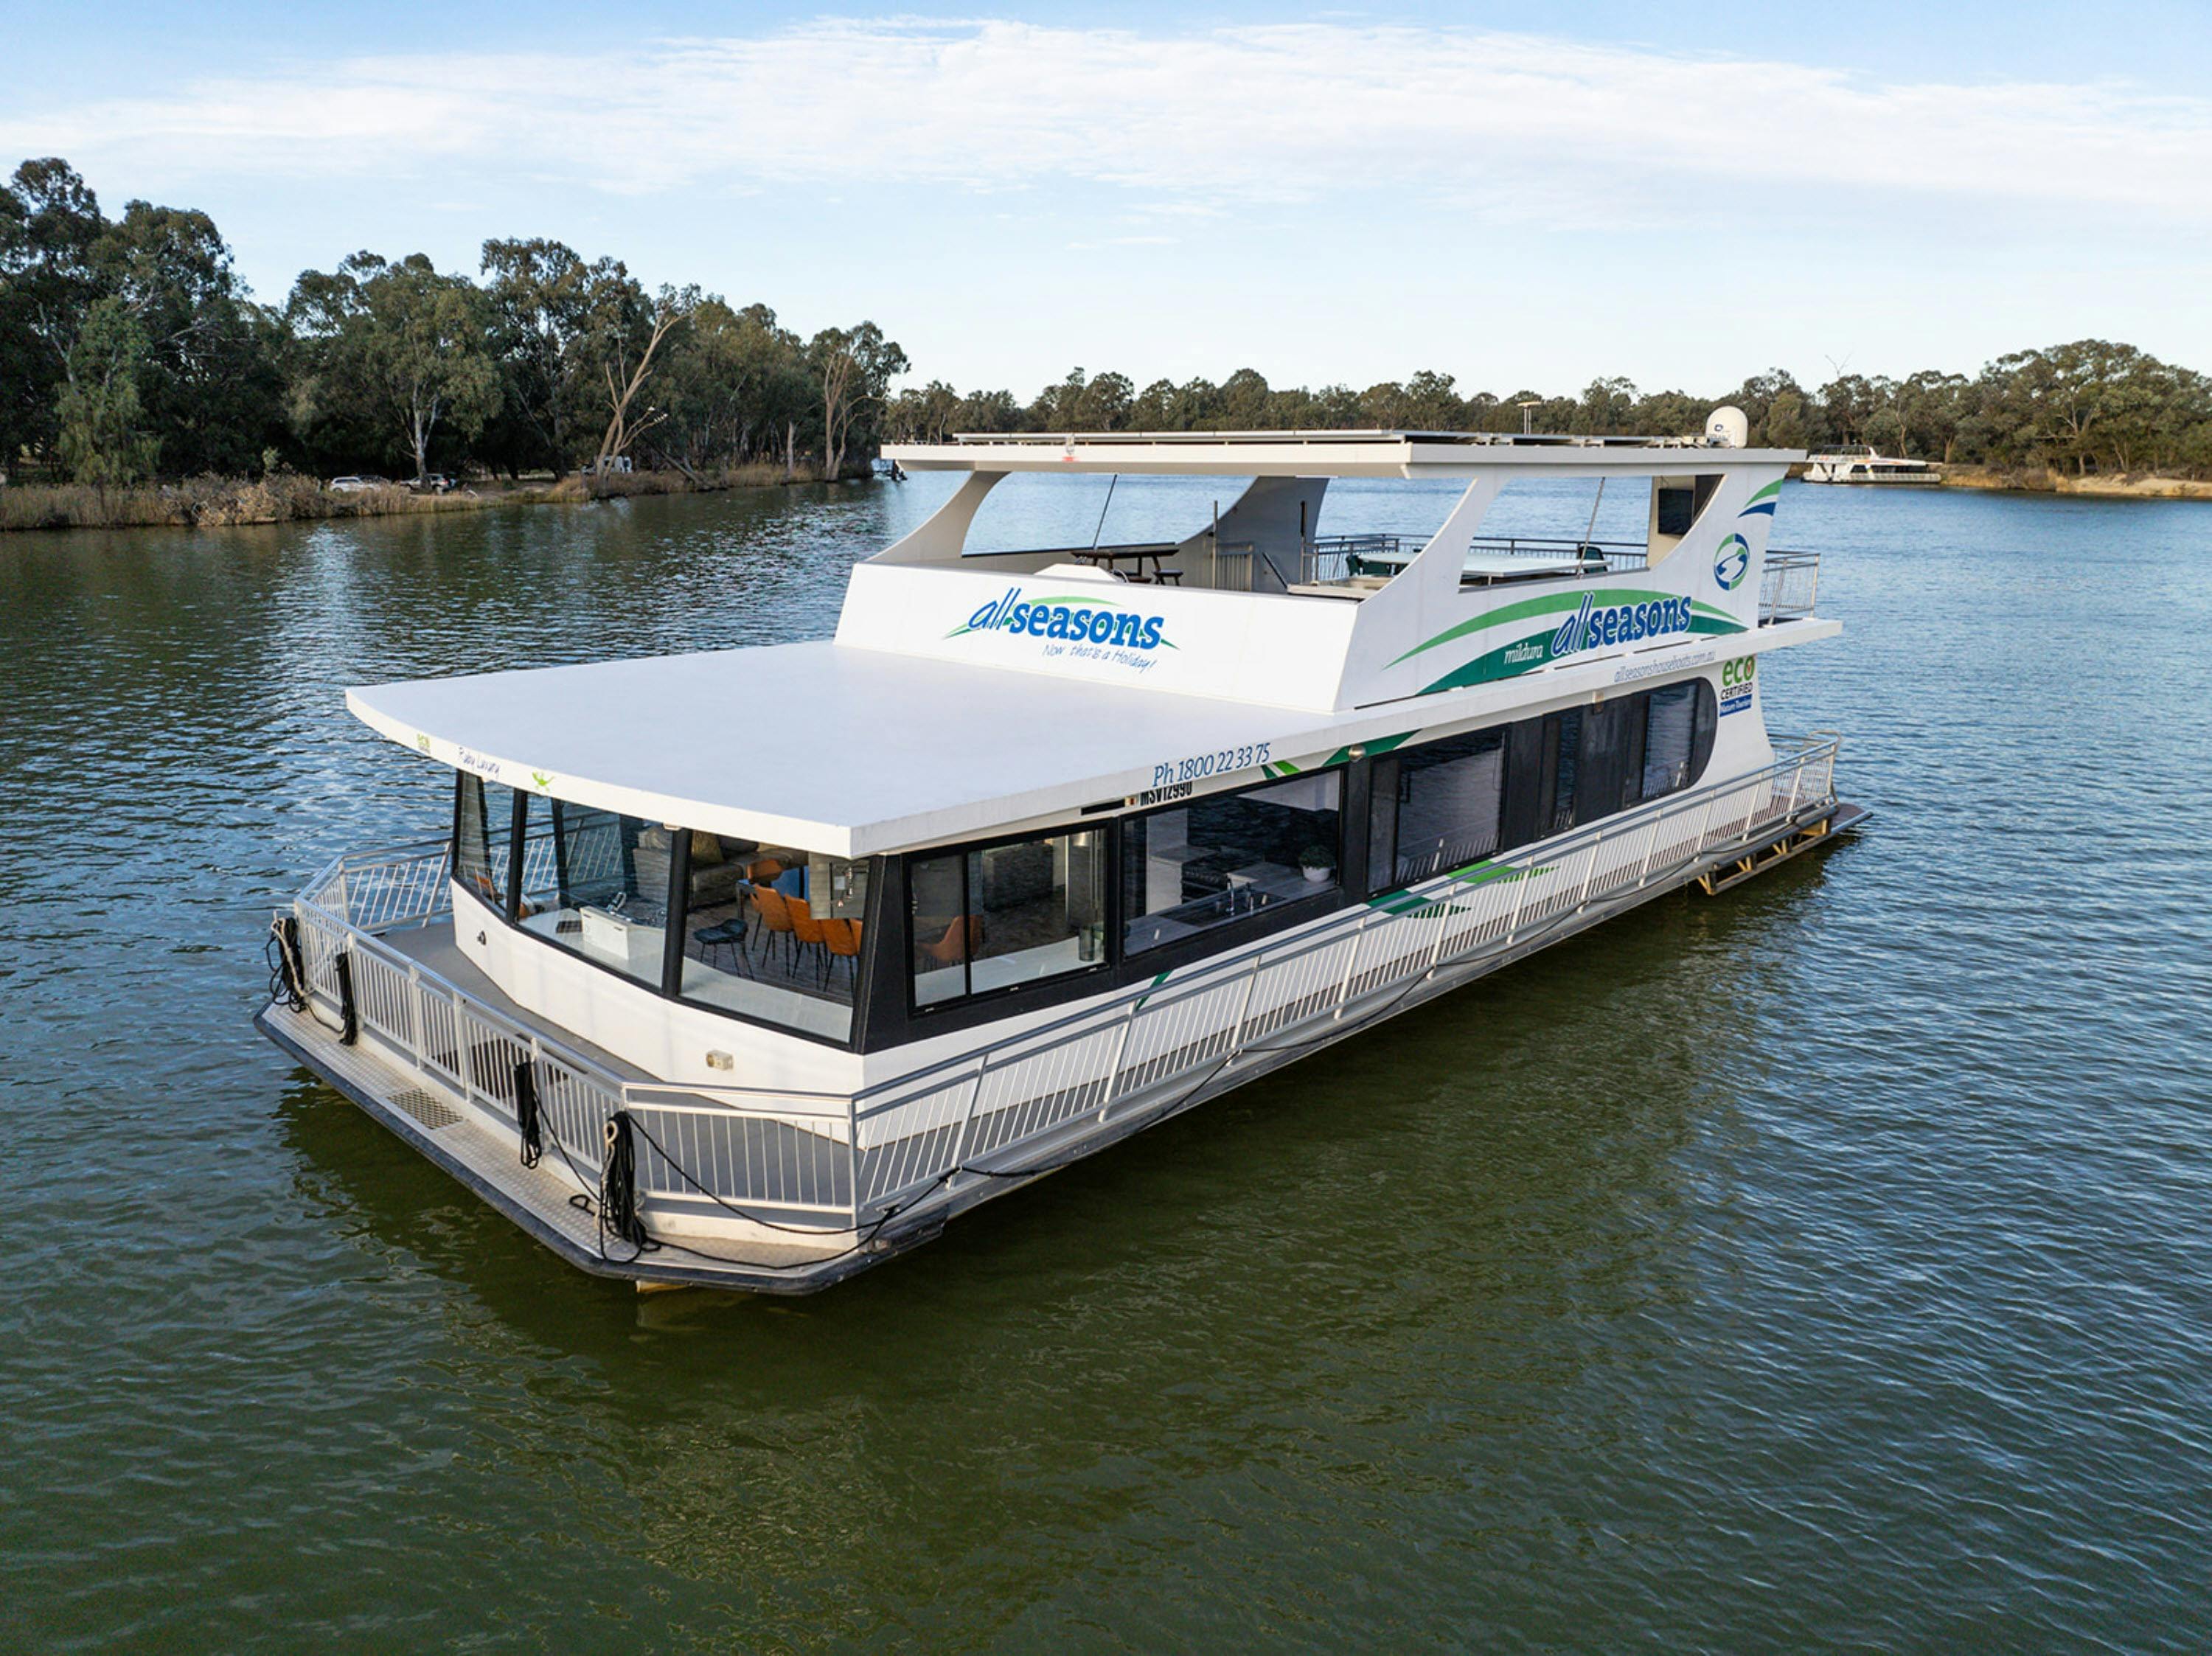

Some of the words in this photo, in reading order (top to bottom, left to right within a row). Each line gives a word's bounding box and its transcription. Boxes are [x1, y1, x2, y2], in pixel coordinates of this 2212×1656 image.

[967, 587, 1164, 650] allseasons
[1504, 641, 1544, 665] mildura
[1552, 592, 1691, 655] allseasons
[1042, 644, 1066, 656] Now
[1069, 644, 1102, 660] that's
[1102, 651, 1110, 660] a
[1112, 649, 1158, 674] Holiday!
[1722, 655, 1755, 686] eco
[1720, 682, 1753, 700] CERTIFIED
[1153, 762, 1174, 787] Ph
[1177, 754, 1214, 782] 1800
[1217, 750, 1234, 773] 22
[1237, 746, 1253, 769] 33
[1256, 742, 1270, 764] 75
